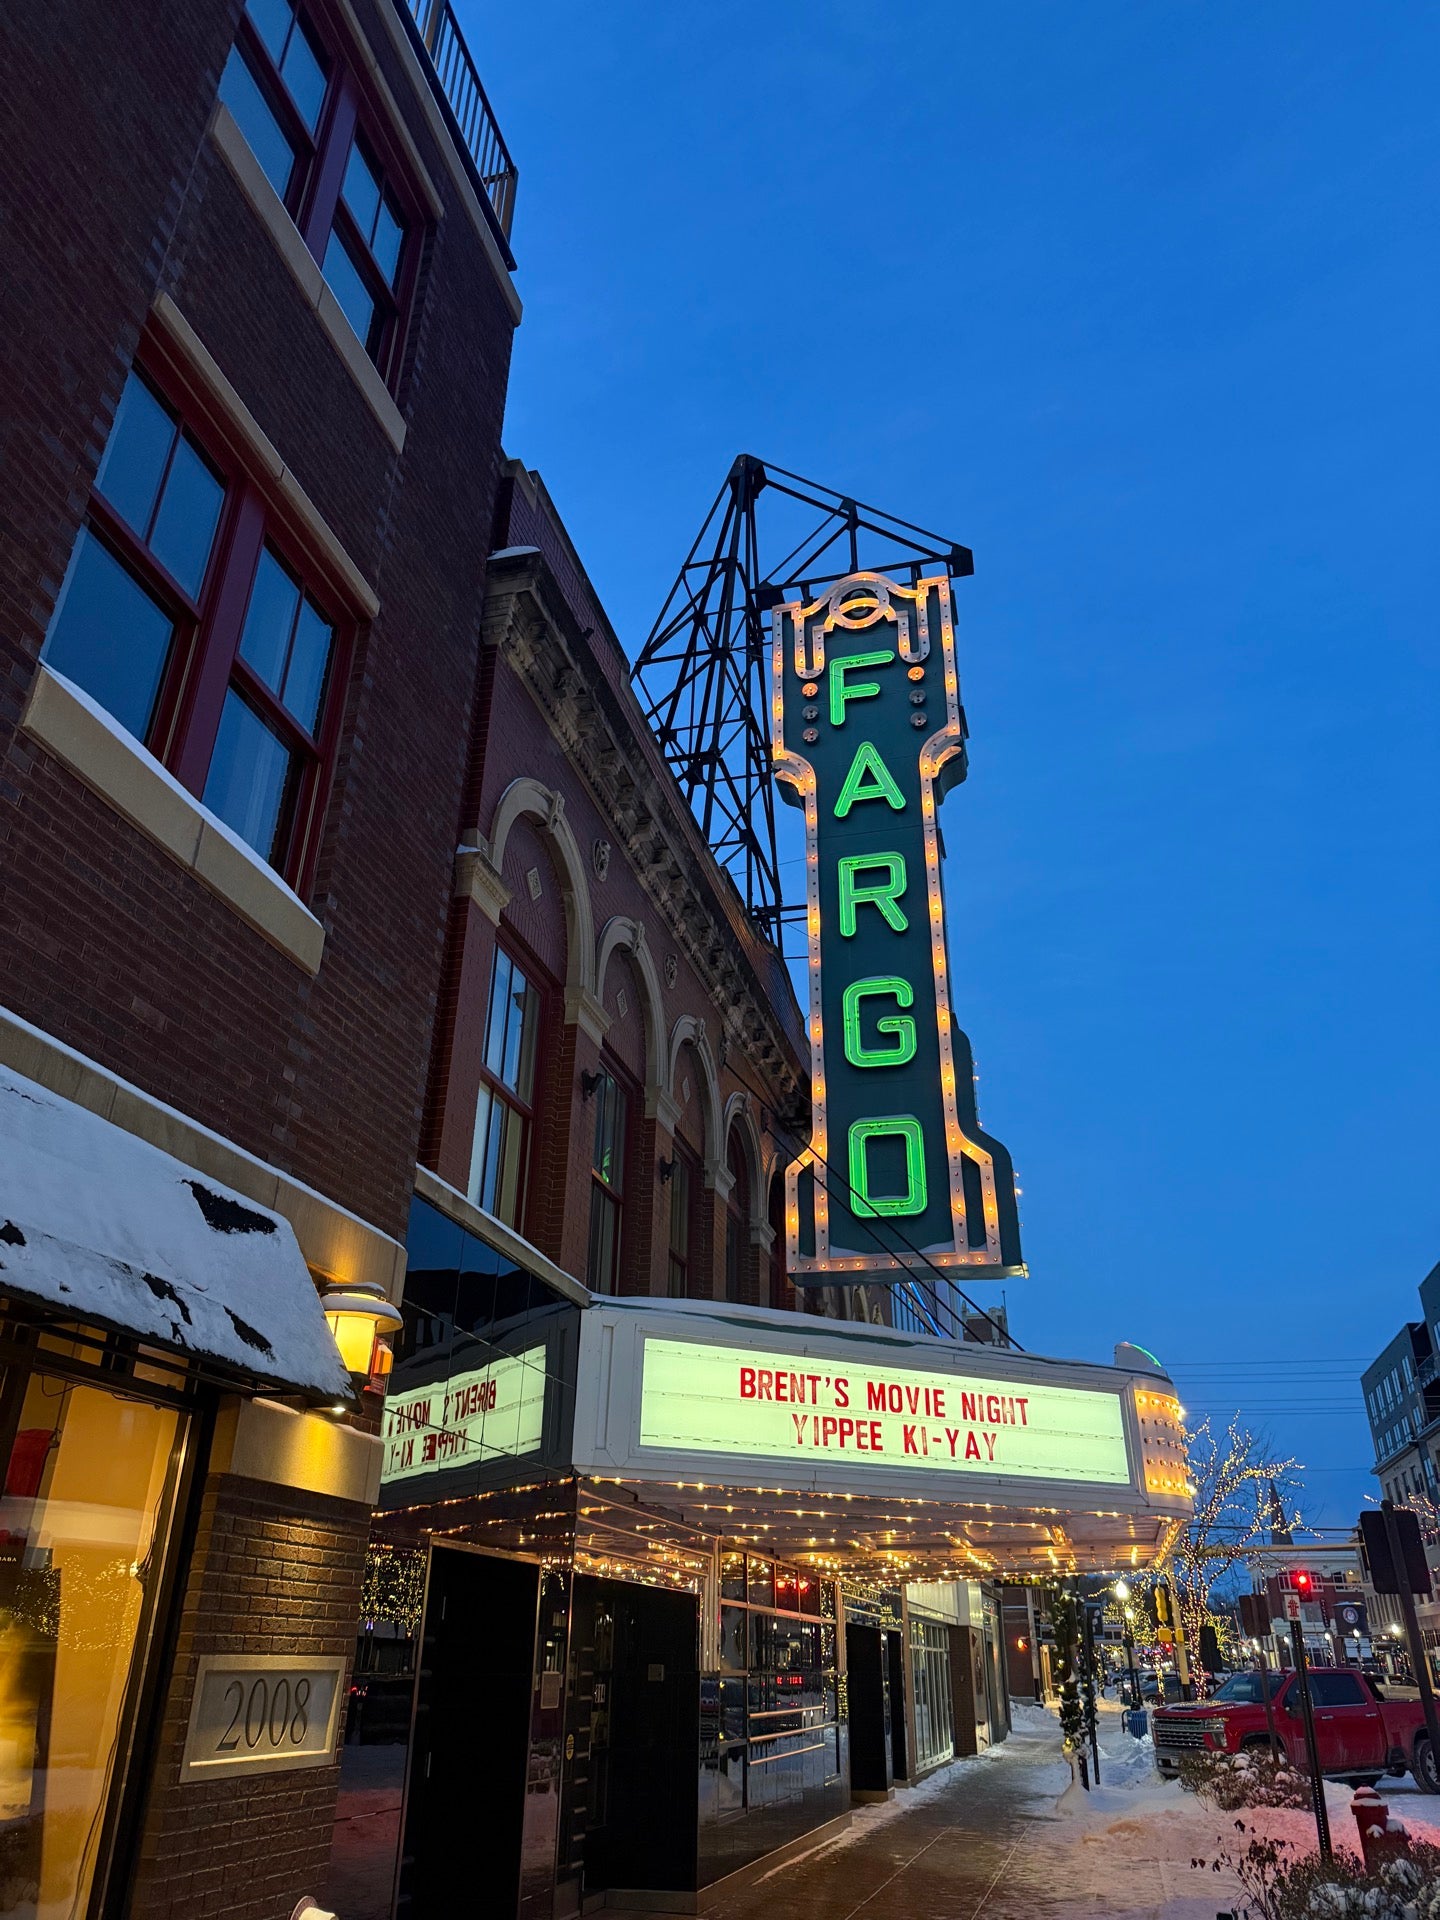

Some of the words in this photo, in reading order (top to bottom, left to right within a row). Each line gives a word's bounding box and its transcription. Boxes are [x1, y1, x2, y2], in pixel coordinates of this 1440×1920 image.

[829, 649, 929, 1220] FARGO
[739, 1366, 849, 1408] BRENT'S
[867, 1380, 946, 1418] MOVIE
[961, 1390, 1030, 1427] NIGHT
[792, 1412, 882, 1452] YIPPEE
[903, 1423, 997, 1462] KI-YAY
[215, 1677, 311, 1752] 2008
